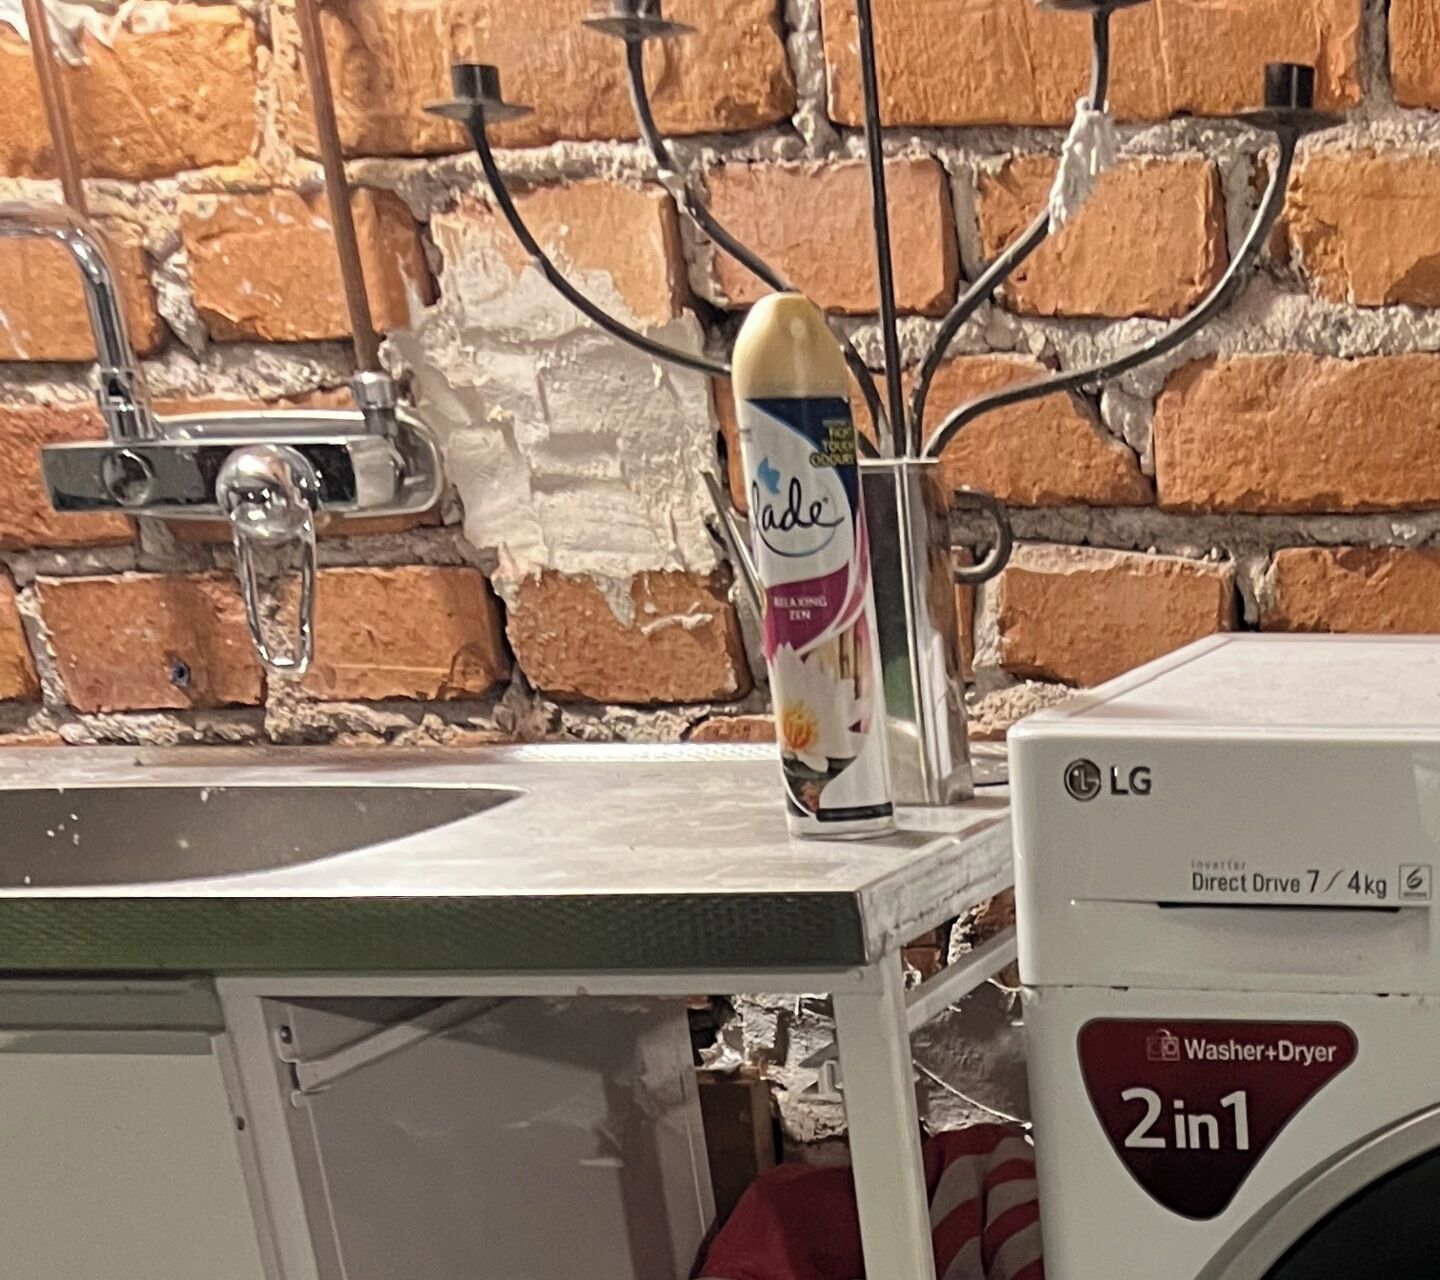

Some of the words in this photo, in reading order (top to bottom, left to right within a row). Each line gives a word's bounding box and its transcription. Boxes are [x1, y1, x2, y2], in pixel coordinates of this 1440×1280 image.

[773, 595, 828, 608] RELAXING
[789, 609, 811, 621] ZEN
[1110, 766, 1151, 795] LG
[1192, 872, 1247, 892] Direct
[1253, 873, 1300, 893] Drive
[1307, 869, 1320, 893] 7
[1184, 1039, 1336, 1066] Washer+Dryer
